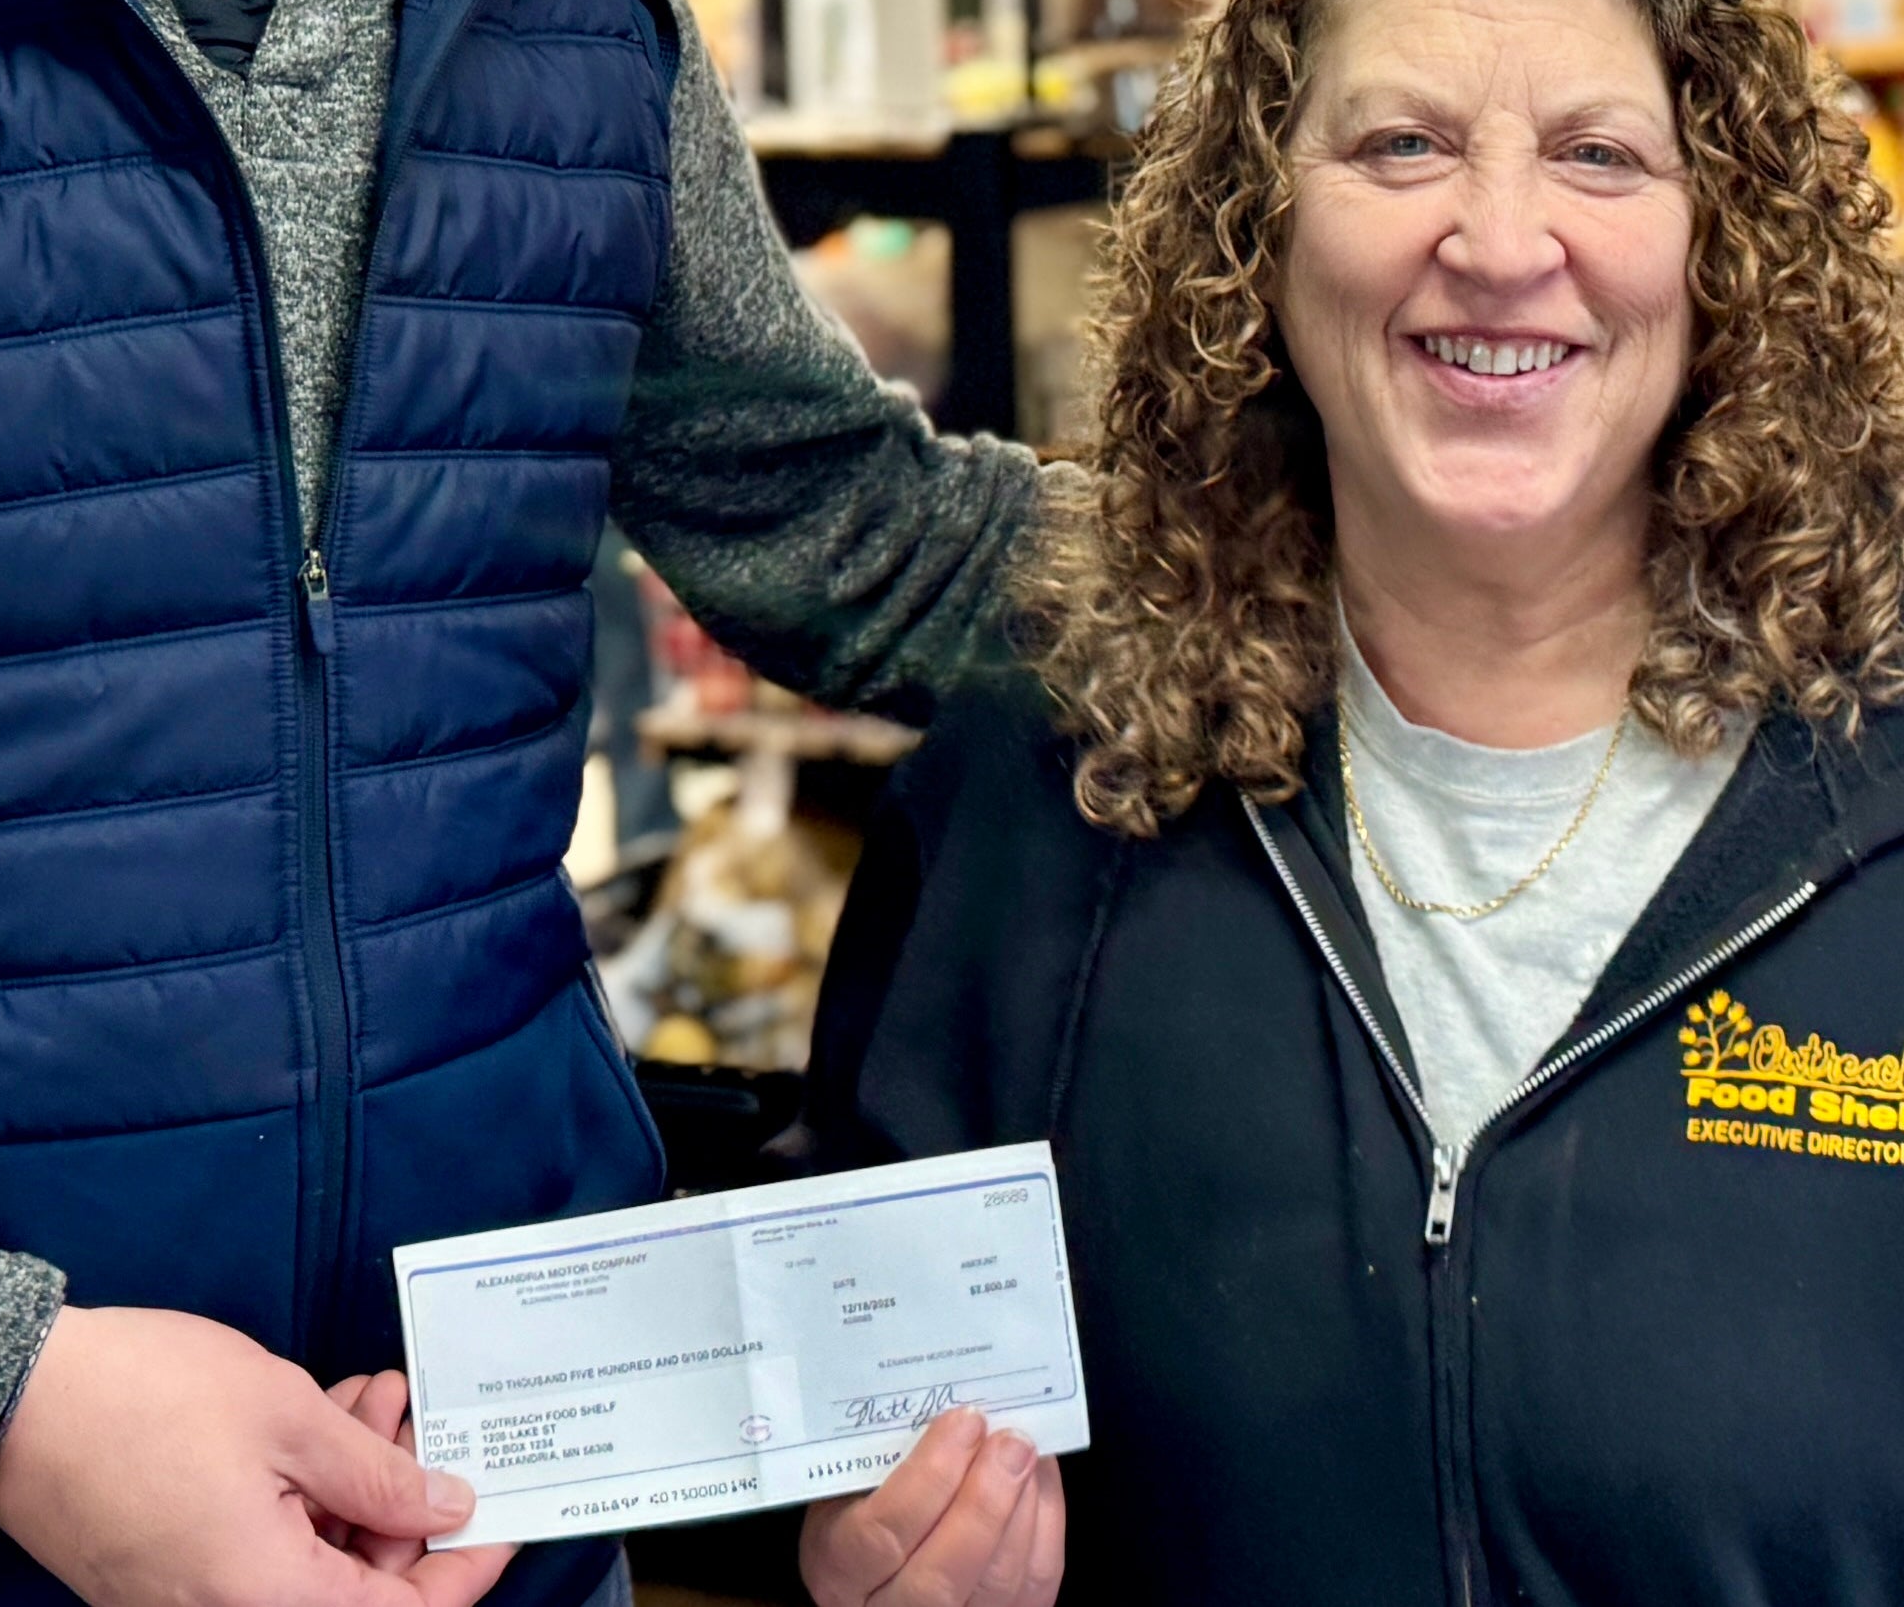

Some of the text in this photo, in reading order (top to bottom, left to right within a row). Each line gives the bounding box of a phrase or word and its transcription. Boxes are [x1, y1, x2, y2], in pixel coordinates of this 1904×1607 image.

[1686, 1078, 1796, 1117] Food
[1686, 1118, 1803, 1153] EXECUTIVE
[476, 1253, 648, 1290] ALEXANDRIA MOTOR COMPANY
[478, 1381, 504, 1394] TWO
[506, 1372, 568, 1391] THOUSAND
[570, 1368, 595, 1382] FIVE
[597, 1359, 652, 1378] HUNDRED
[655, 1354, 679, 1369] AND
[711, 1341, 764, 1360] DOLLARS
[425, 1419, 447, 1433] PAY
[480, 1401, 617, 1430] OUTREACH FOOD SHELF
[427, 1431, 469, 1448] TO THE
[508, 1425, 539, 1440] LAKE
[542, 1423, 557, 1435] ST
[427, 1447, 471, 1464] ORDER
[483, 1445, 500, 1458] PO
[502, 1441, 526, 1455] BOX
[484, 1450, 560, 1471] ALEXANDRIA,
[563, 1446, 580, 1459] MN
